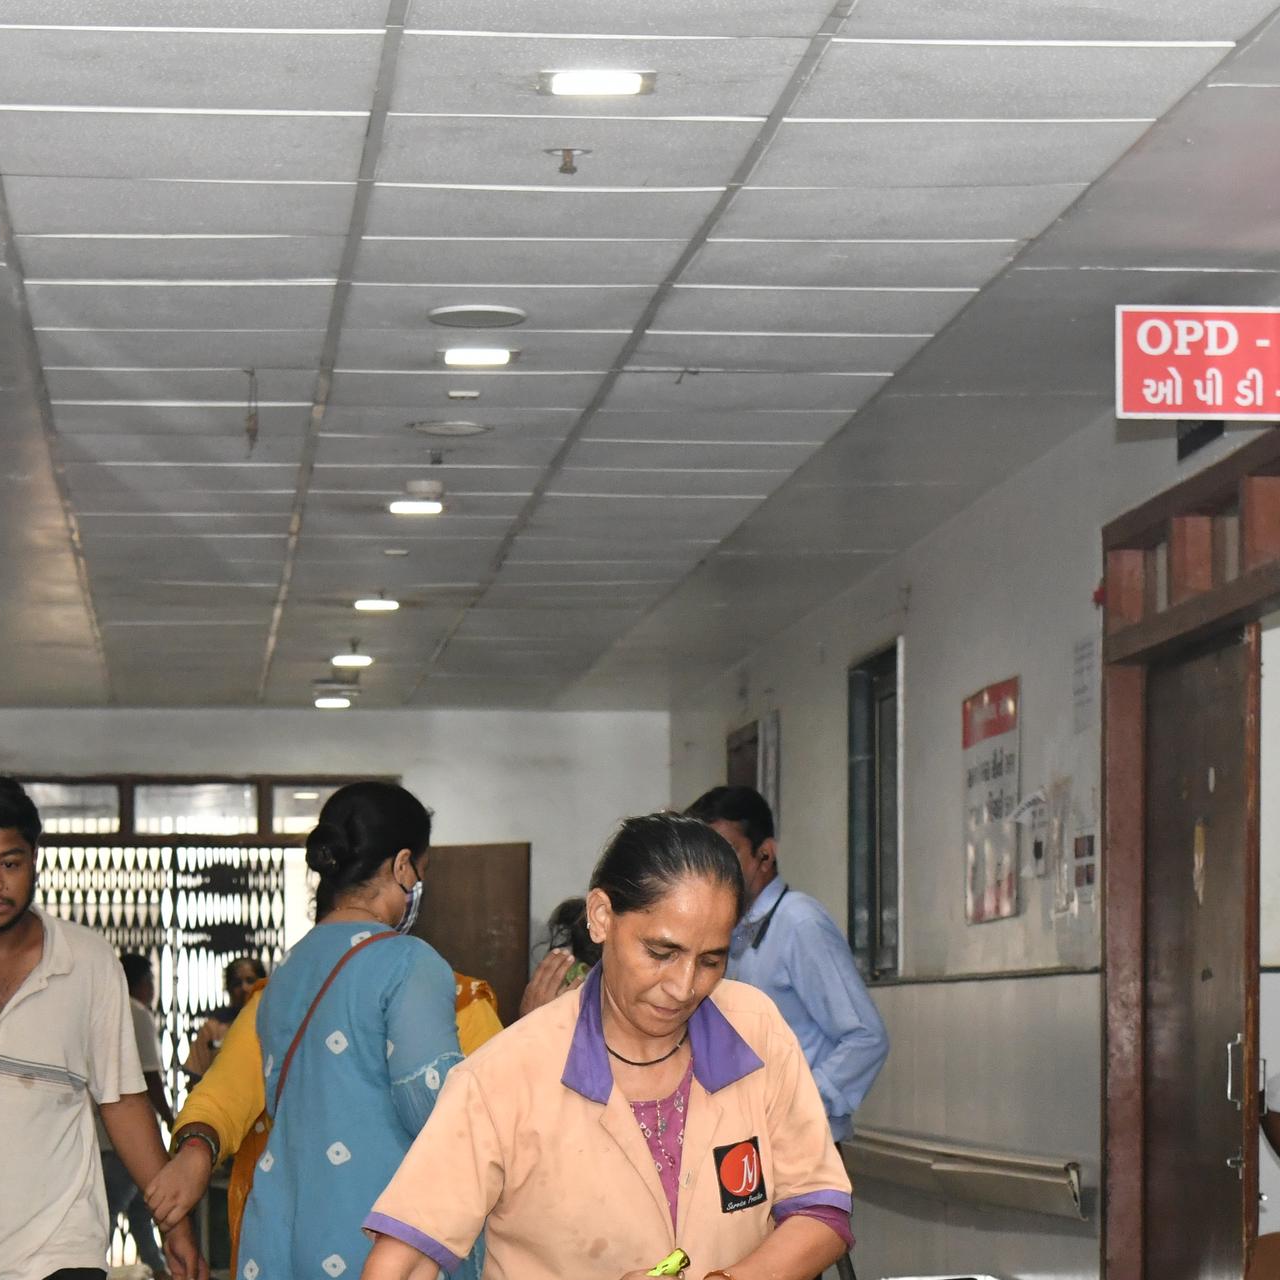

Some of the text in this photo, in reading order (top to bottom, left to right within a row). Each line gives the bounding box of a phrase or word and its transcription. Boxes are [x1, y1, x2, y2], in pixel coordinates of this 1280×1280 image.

[1136, 319, 1239, 356] OPD
[1256, 339, 1270, 347] -
[1142, 366, 1183, 405] ઓ
[1193, 367, 1223, 406] પી
[1234, 367, 1264, 407] ડી
